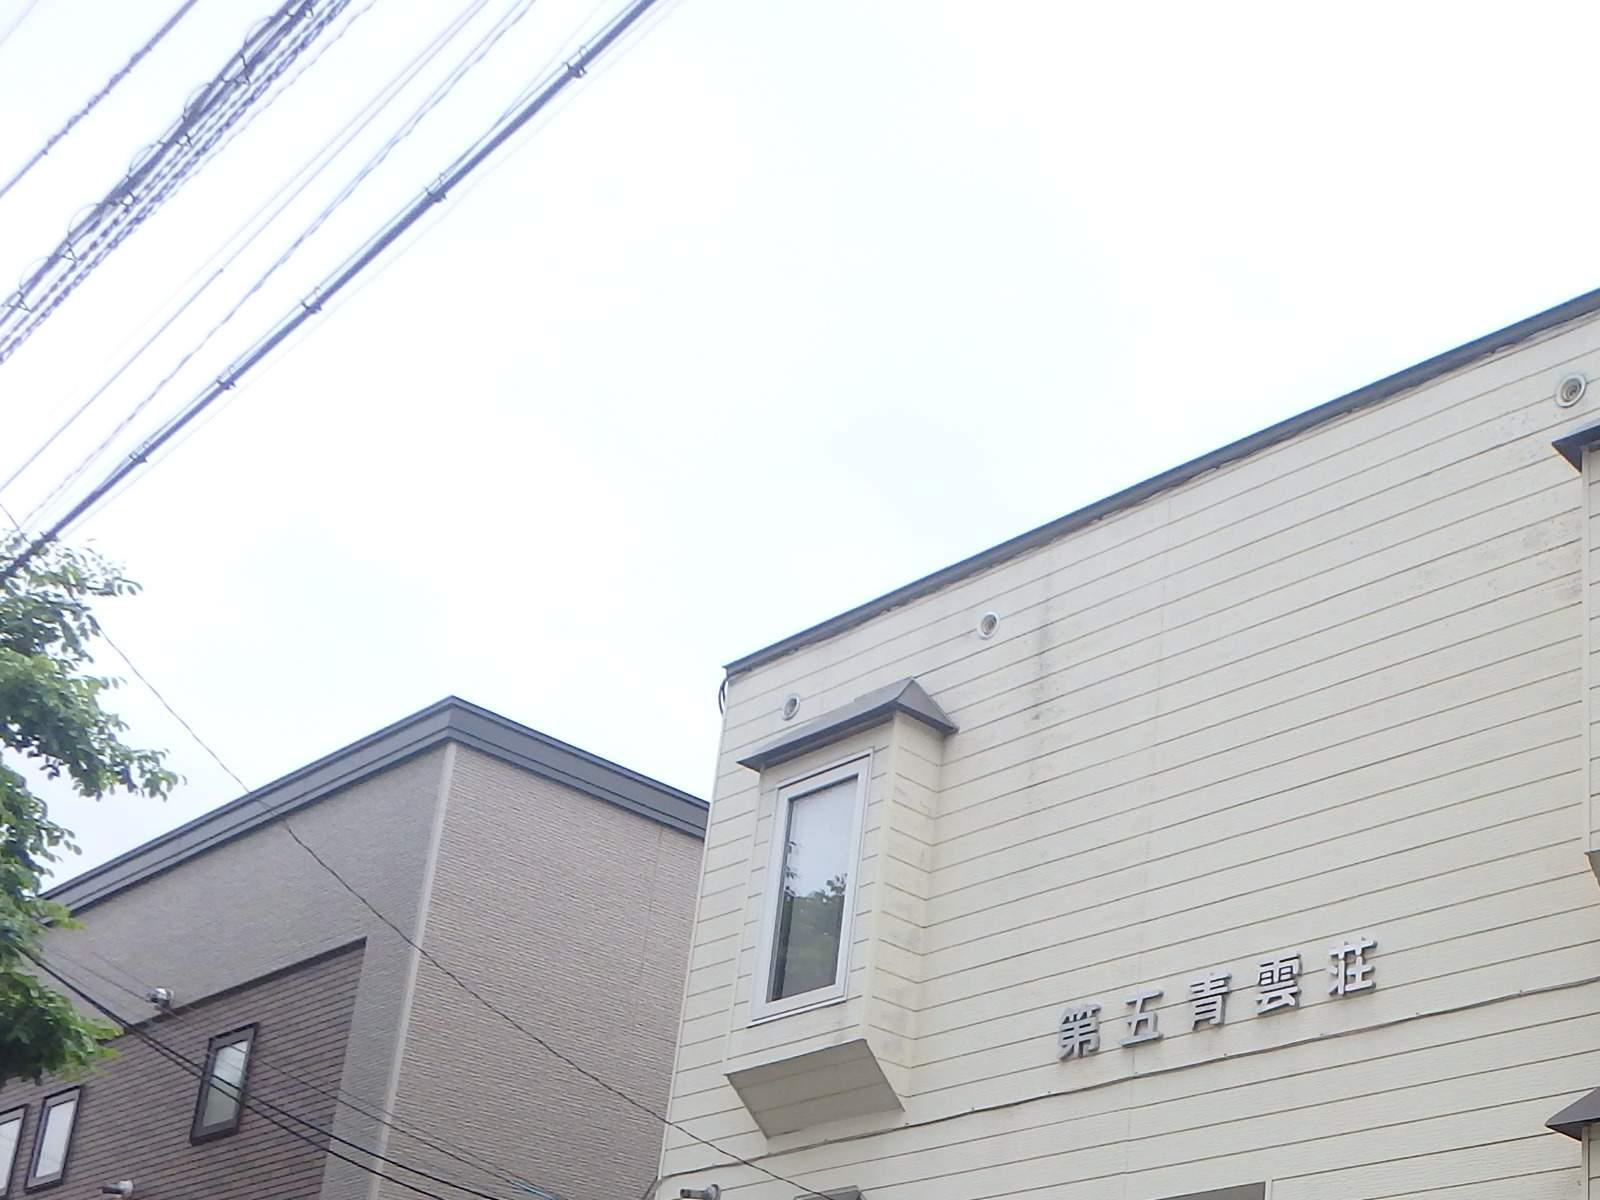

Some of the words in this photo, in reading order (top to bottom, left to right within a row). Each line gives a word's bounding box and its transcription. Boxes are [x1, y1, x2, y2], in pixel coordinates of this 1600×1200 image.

[1056, 936, 1377, 1060] 第五青雲荘
